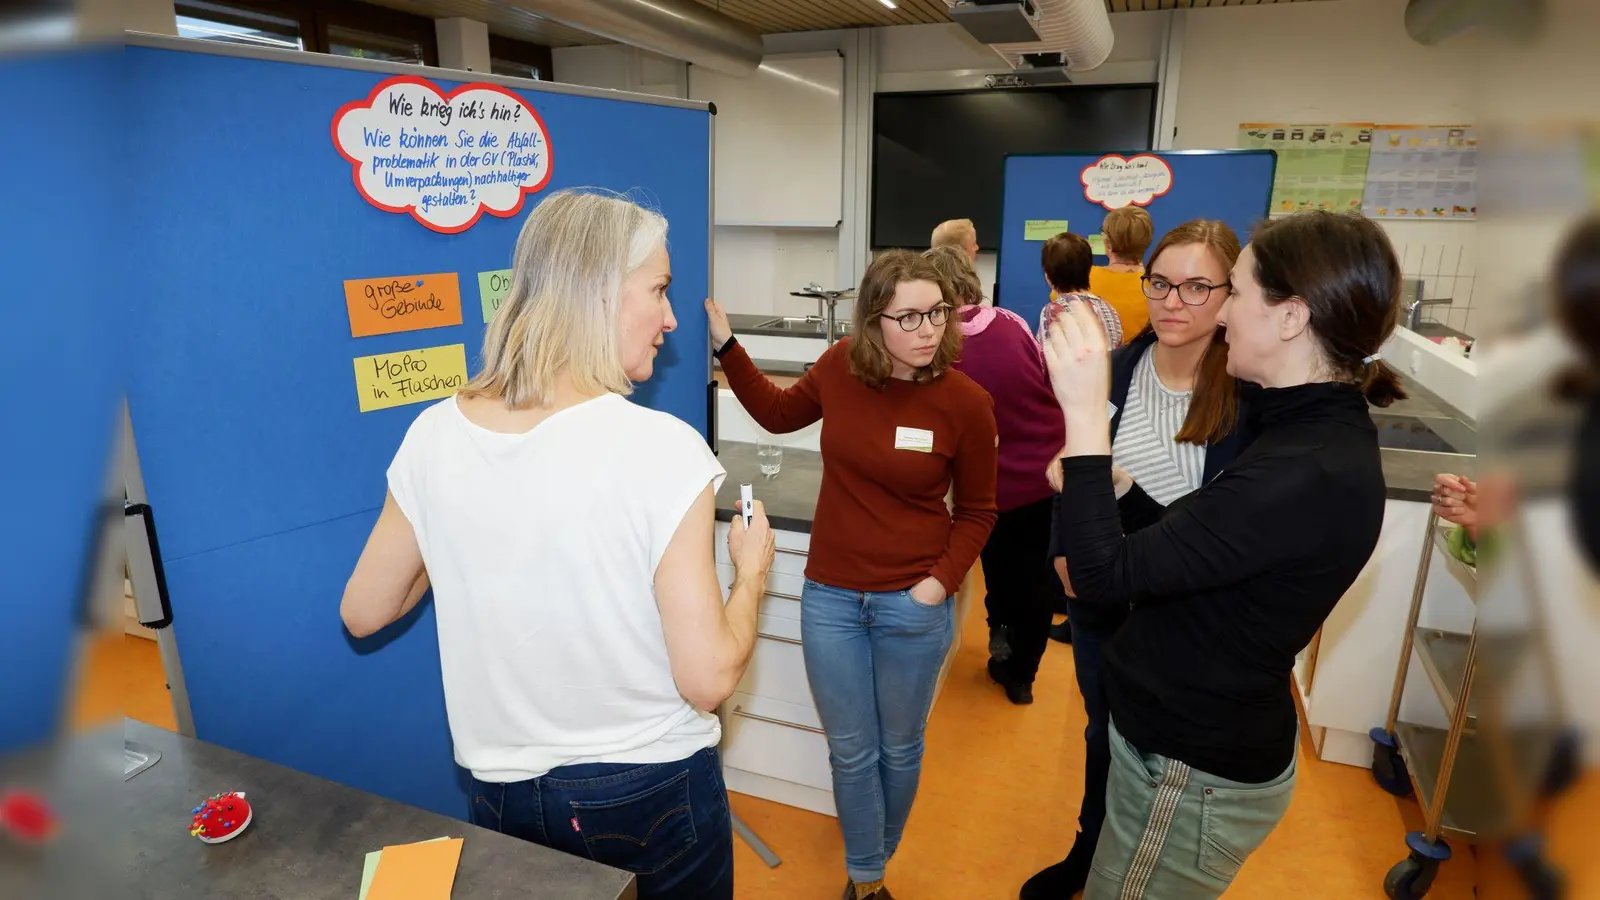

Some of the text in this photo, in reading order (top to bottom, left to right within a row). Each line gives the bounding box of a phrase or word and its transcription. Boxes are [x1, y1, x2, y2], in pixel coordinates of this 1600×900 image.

[389, 91, 521, 126] Wie krieg ich's hin?
[363, 126, 542, 152] Wie können Sie die Abfall-
[372, 152, 440, 174] problematik
[445, 154, 457, 169] in
[460, 151, 480, 168] der
[481, 152, 499, 169] GV
[384, 170, 531, 192] Umverpackungen) nachhaltiger
[421, 189, 477, 213] gestalten?
[381, 292, 445, 319] Gebinde
[372, 374, 462, 399] in Flaschen
